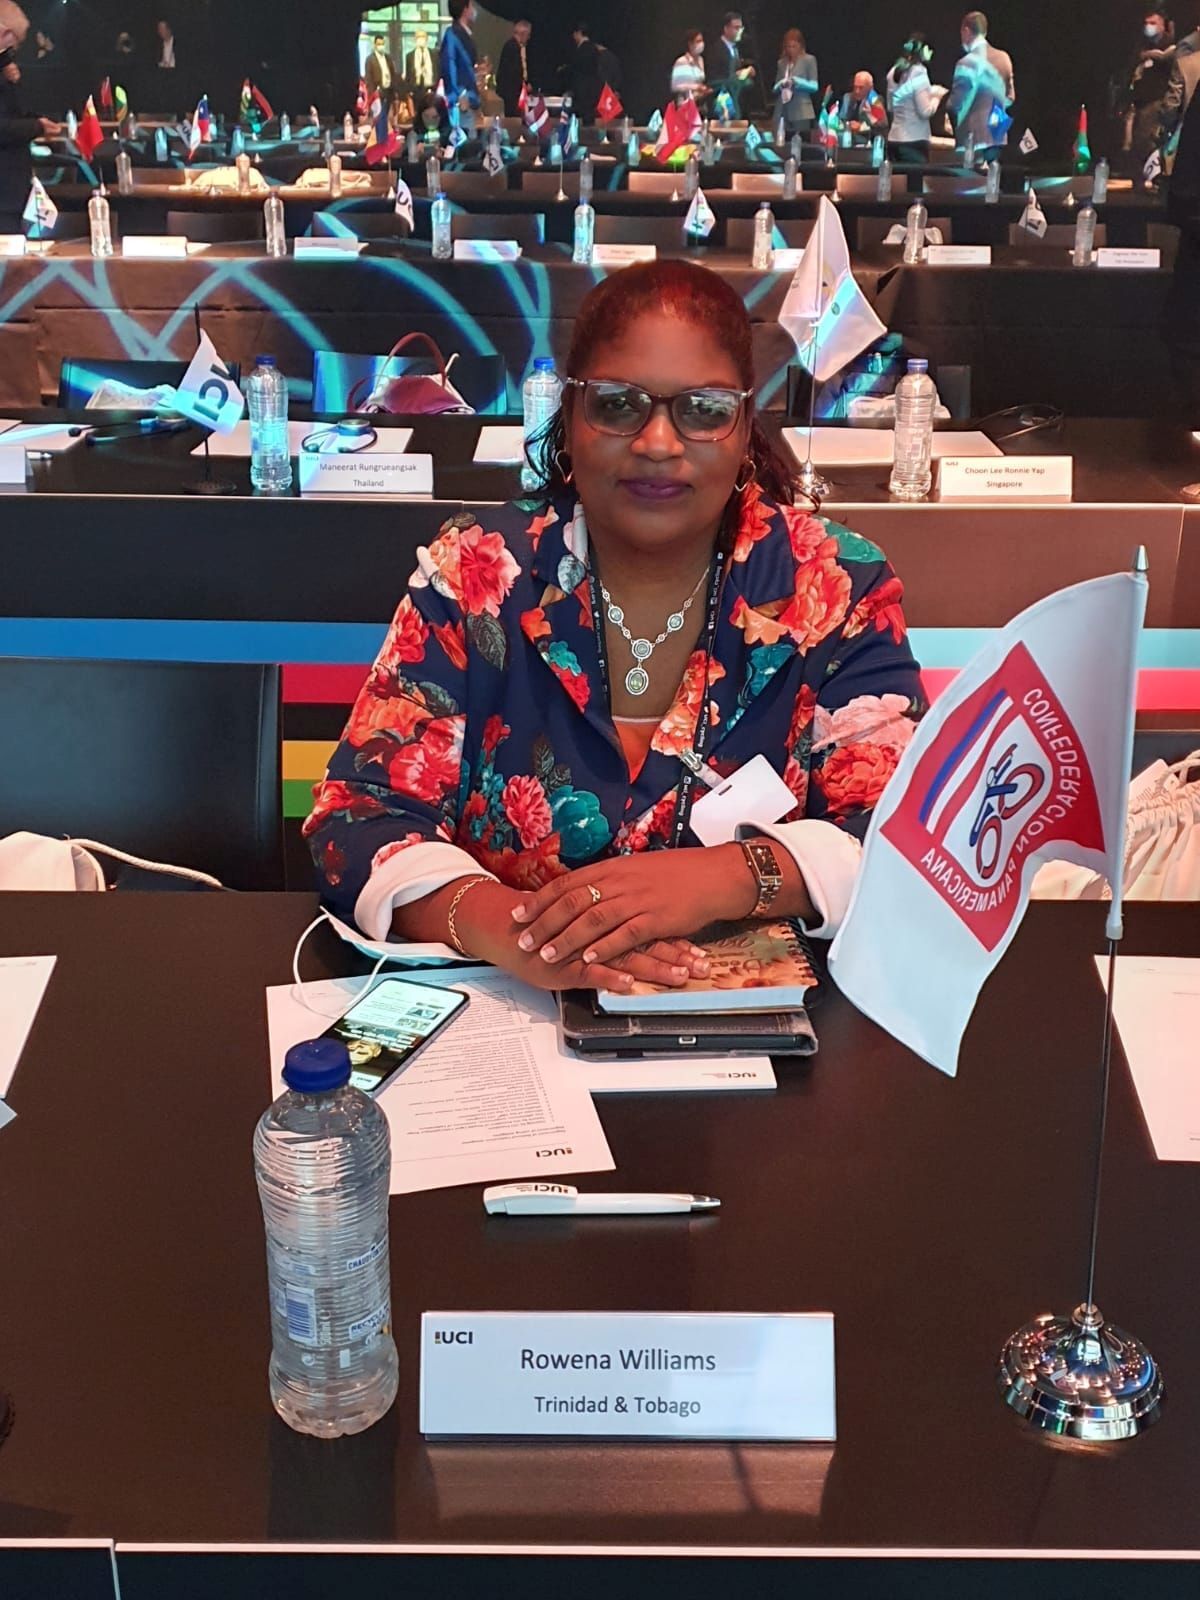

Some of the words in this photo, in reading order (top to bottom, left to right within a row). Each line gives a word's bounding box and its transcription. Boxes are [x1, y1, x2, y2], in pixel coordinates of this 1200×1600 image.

[319, 463, 357, 471] Maneerat
[359, 463, 417, 473] Rungrueangsak
[1031, 467, 1045, 475] Yap
[353, 479, 385, 487] Thailand
[986, 480, 1023, 489] Singapore
[535, 1148, 565, 1158] UCI
[534, 1184, 563, 1193] UCI
[441, 1331, 474, 1345] UCI
[520, 1348, 612, 1371] Rowena
[618, 1348, 717, 1371] Williams
[533, 1396, 609, 1414] Trinidad
[614, 1397, 629, 1414] &
[634, 1396, 701, 1418] Tobago
